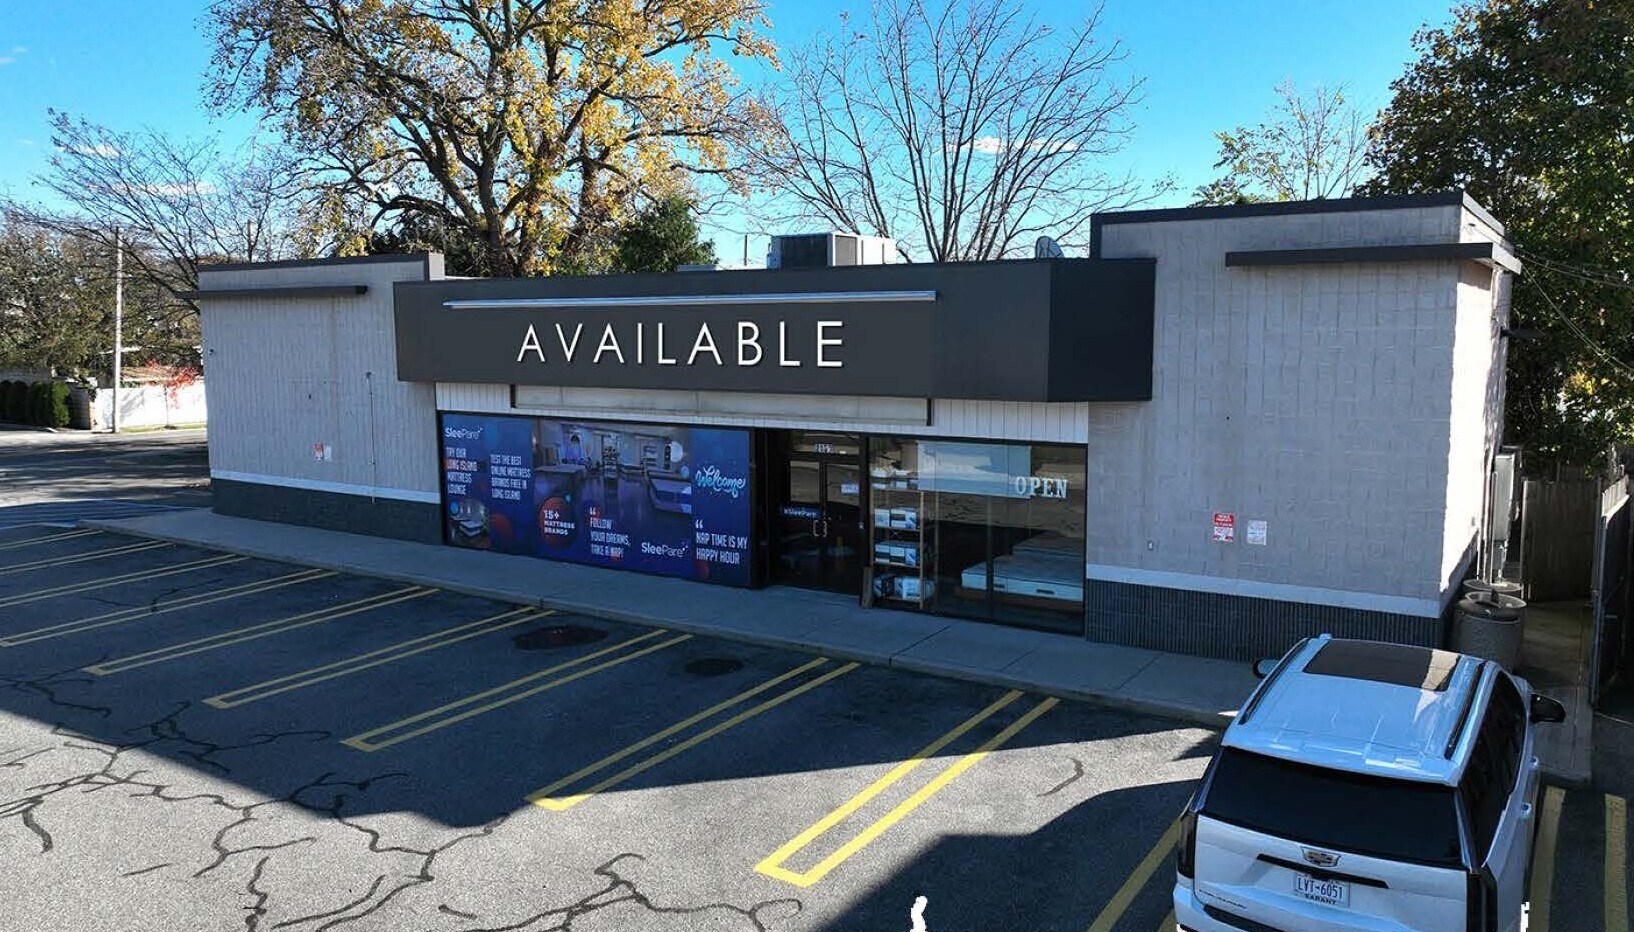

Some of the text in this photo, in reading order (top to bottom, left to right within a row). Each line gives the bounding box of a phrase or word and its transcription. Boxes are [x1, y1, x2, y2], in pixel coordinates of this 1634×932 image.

[517, 320, 843, 368] AVAILABLE
[446, 447, 466, 458] TRY OUR
[447, 459, 478, 471] LONG ISLAND
[490, 454, 521, 465] TEST THE BEST
[448, 472, 472, 483] MATTRESS
[491, 465, 531, 478] ONLINE MATTRESS
[491, 477, 509, 488] BRANDS
[511, 479, 521, 489] FREE
[695, 465, 746, 498] Welcome
[1016, 476, 1068, 499] OPEN
[448, 484, 466, 495] LOUNGE
[491, 488, 520, 500] LONG ISLAND
[544, 509, 560, 520] 15+
[544, 519, 575, 529] MATTRESS
[590, 517, 613, 530] FOLLOW
[544, 527, 568, 536] BRANDS
[590, 531, 605, 543] YOUR
[696, 532, 748, 549] NAP TIME IS MY
[591, 543, 604, 556] TAKE
[641, 542, 683, 557] SleePare
[696, 548, 740, 564] HAPPY HOUR
